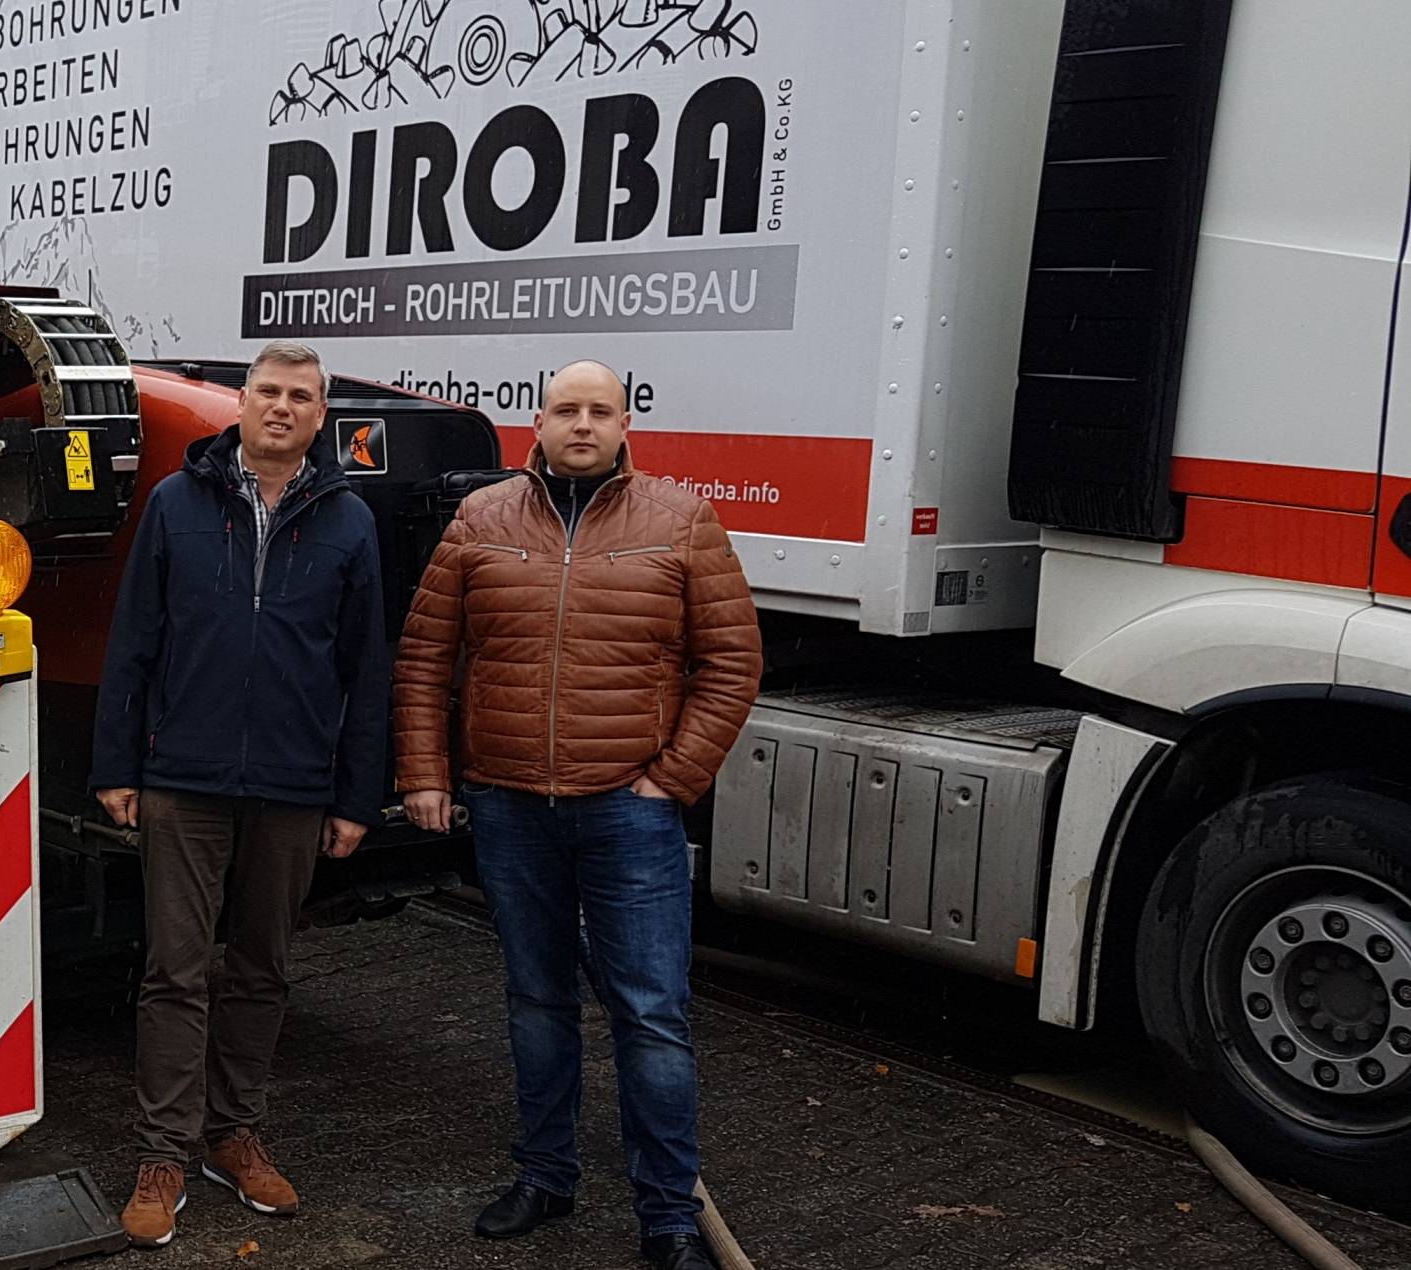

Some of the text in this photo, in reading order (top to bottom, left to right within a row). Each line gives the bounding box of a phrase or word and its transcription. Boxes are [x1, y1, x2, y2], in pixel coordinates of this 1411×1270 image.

[262, 76, 766, 264] DIROBA
[773, 148, 788, 162] &
[10, 167, 173, 221] KABELZUG
[767, 170, 786, 231] GmbH
[259, 286, 376, 326] DITTRICH
[405, 268, 759, 323] ROHRLEITUNGSBAU
